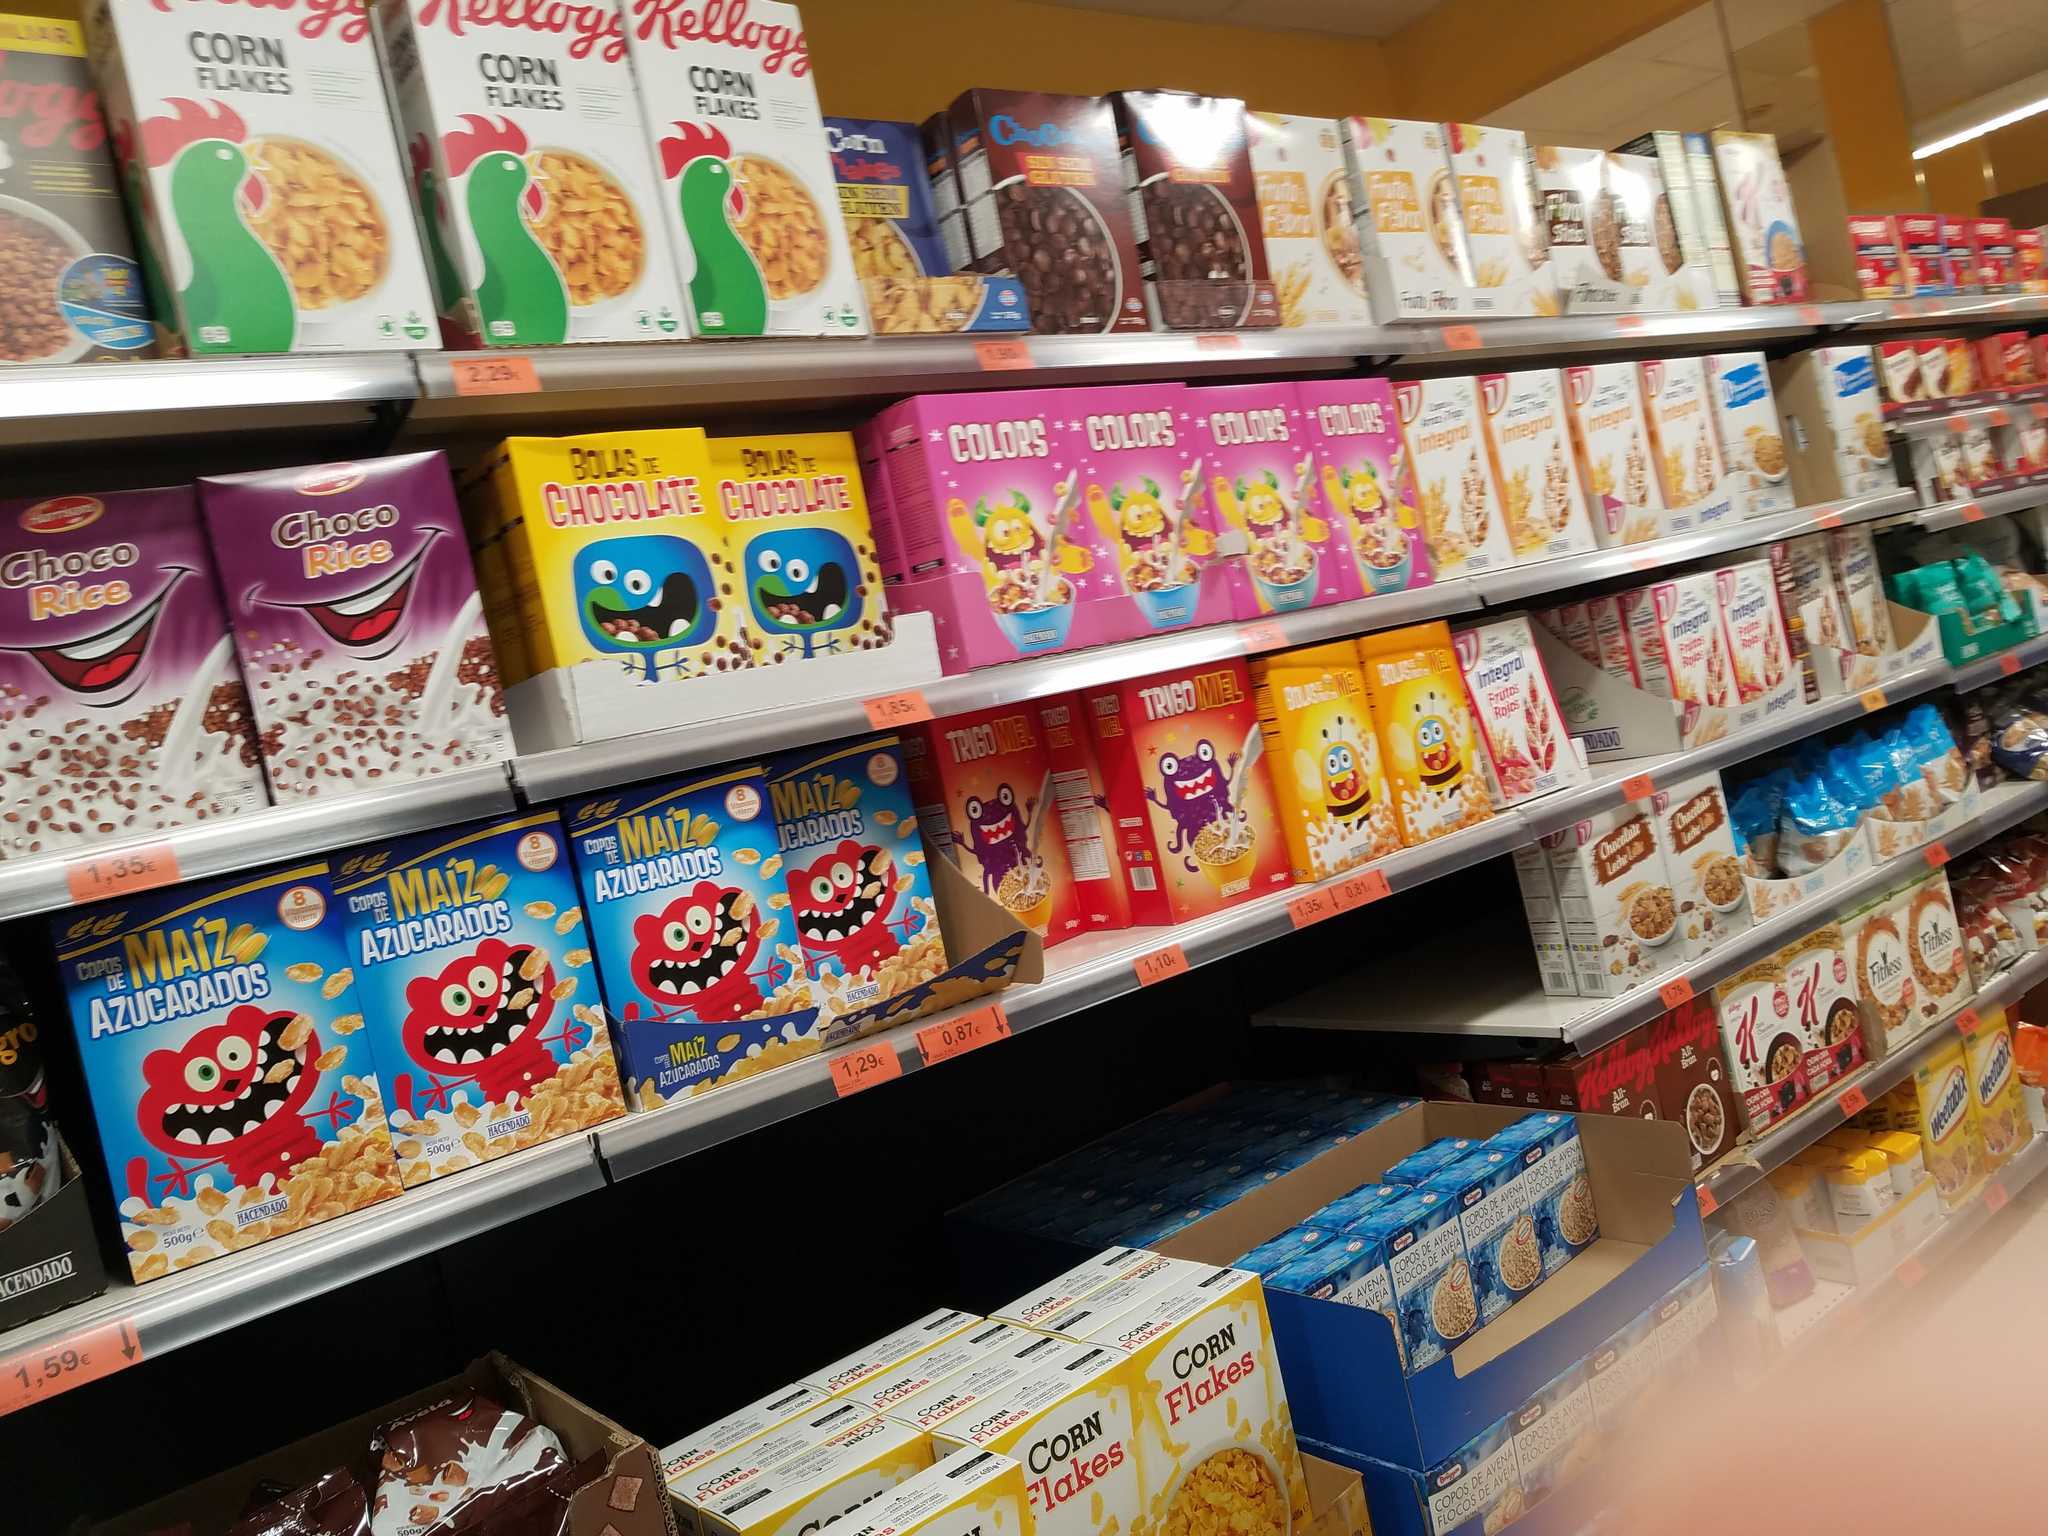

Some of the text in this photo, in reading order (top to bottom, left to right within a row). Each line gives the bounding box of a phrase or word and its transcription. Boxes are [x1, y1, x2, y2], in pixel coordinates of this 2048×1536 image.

[189, 31, 288, 69] CORN
[194, 66, 293, 95] FLAKES
[480, 53, 561, 87] CORN
[688, 65, 757, 98] CORN
[485, 86, 565, 111] FLAKES
[696, 95, 761, 120] FLAKES
[1086, 411, 1176, 452] COLORS
[1209, 408, 1291, 446] COLORS
[1318, 402, 1386, 437] COLORS
[947, 418, 1049, 463] COLORS
[569, 448, 662, 481] BOLAS DE
[740, 448, 817, 478] BOLAS DE
[542, 475, 706, 529] CHOCOLATE
[719, 475, 852, 521] CHOCOLATE
[271, 504, 399, 549] Choco
[0, 543, 139, 588] Choco
[303, 540, 394, 579] Rice
[28, 580, 132, 621] Rice
[1476, 650, 1526, 689] Integral
[1138, 669, 1245, 721] TRIGO MIEL
[1488, 683, 1521, 703] Frutos
[1493, 699, 1521, 720] Rojos
[944, 714, 1038, 764] TRIGO MIEL
[736, 788, 746, 801] 8
[769, 773, 842, 824] MAÍZ
[529, 835, 541, 850] 8
[584, 836, 617, 856] COPOS
[617, 806, 698, 863] MAÍZ
[86, 856, 159, 886] 1,35€
[604, 848, 620, 865] DE
[350, 891, 388, 914] COPOS
[386, 857, 482, 922] MAÍZ
[594, 846, 722, 903] AZUCARADOS
[293, 891, 305, 906] 8
[374, 906, 391, 924] DE
[360, 900, 512, 967] AZUCARADOS
[1920, 927, 1953, 955] Fitness
[75, 916, 237, 991] COPOS MAÍZ
[1144, 954, 1177, 974] 1,10€
[107, 975, 125, 994] DE
[1868, 957, 1903, 986] Fitness
[88, 963, 271, 1041] AZUCARADOS
[1797, 960, 1821, 1027] K
[942, 1022, 983, 1047] 0,87€
[1736, 995, 1759, 1065] K
[669, 1035, 708, 1067] MAÍZ
[842, 1052, 886, 1078] 1,29€
[1681, 1045, 1694, 1060] All-
[1681, 1054, 1697, 1070] Bran
[659, 1054, 721, 1088] AZUCARADOS
[1979, 1038, 2012, 1102] Weetabix
[1612, 1098, 1630, 1114] Bran
[1613, 1087, 1627, 1103] All-
[1931, 1074, 1968, 1141] Weetabix
[488, 1116, 530, 1138] HACENDADO
[427, 1143, 453, 1158] 500g
[1527, 1164, 1547, 1185] COPOS
[236, 1199, 289, 1227] HACENDADO
[1464, 1205, 1488, 1228] COPOS
[1489, 1197, 1499, 1209] DE
[1500, 1182, 1524, 1205] AVENA
[1467, 1217, 1495, 1241] FLOCOS
[1496, 1210, 1505, 1223] DE
[1507, 1193, 1527, 1216] AVEIA
[163, 1233, 194, 1250] 500g
[1394, 1252, 1420, 1275] COPOS
[1421, 1242, 1432, 1256] DE
[1433, 1224, 1460, 1249] AVENA
[1396, 1238, 1462, 1289] FLOCOS DE AVEIA
[1356, 1272, 1387, 1298] AVENA
[1364, 1287, 1389, 1309] AVEIA
[1021, 1296, 1057, 1317] CORN
[1022, 1296, 1073, 1324] Flakes
[1118, 1321, 1154, 1343] CORN
[1119, 1320, 1173, 1352] Flakes
[1172, 1322, 1238, 1380] CORN
[15, 1352, 91, 1390] 1,59€
[828, 1363, 868, 1384] CORN
[828, 1362, 883, 1392] Flakes
[873, 1378, 914, 1401] CORN
[873, 1378, 930, 1409] Flakes
[1164, 1350, 1256, 1427] Flakes
[917, 1394, 959, 1417] CORN
[918, 1394, 977, 1427] Flakes
[969, 1409, 1011, 1433] CORN
[970, 1410, 1031, 1444] Flakes
[1028, 1410, 1105, 1476] CORN
[1519, 1422, 1549, 1451] COPOS
[666, 1449, 716, 1476] lakes
[1026, 1440, 1125, 1513] Flakes
[694, 1467, 760, 1503] Flakes
[697, 1466, 743, 1492] CORN
[1434, 1447, 1513, 1513] COPOS DE AVENA
[1437, 1463, 1517, 1529] FLOCOS DE AVEIA
